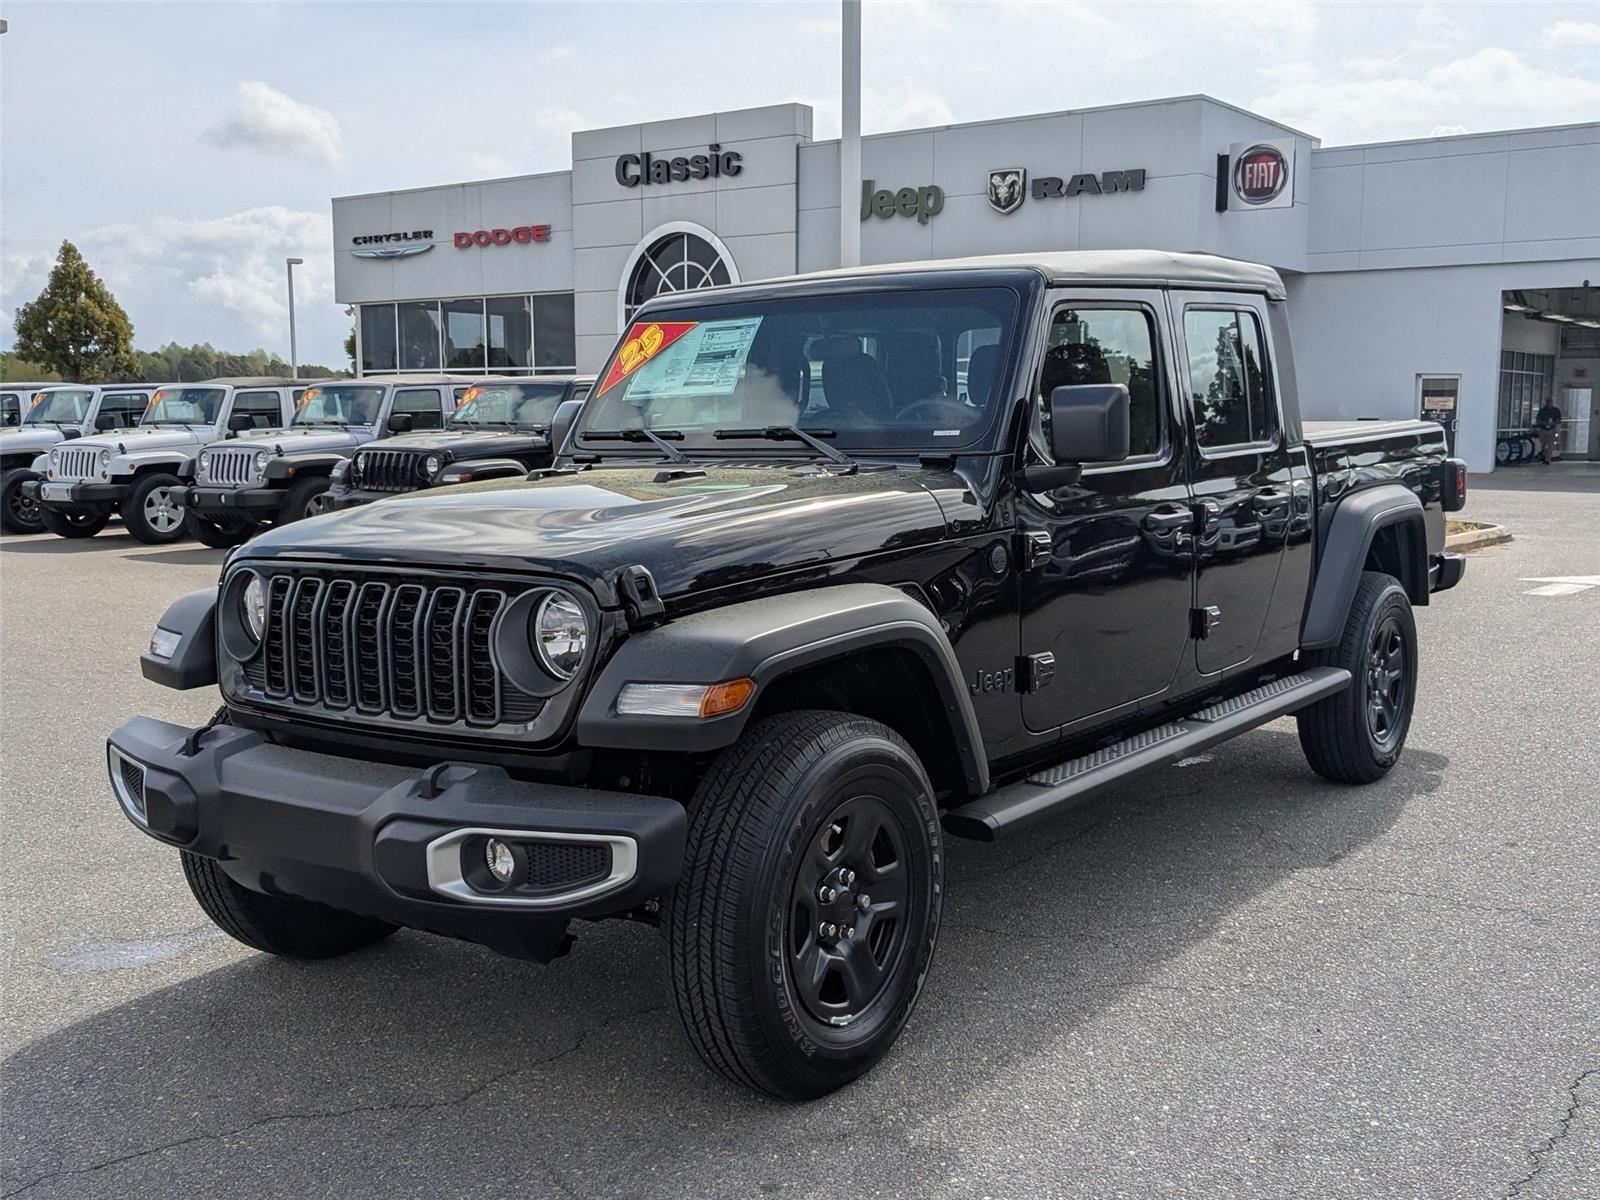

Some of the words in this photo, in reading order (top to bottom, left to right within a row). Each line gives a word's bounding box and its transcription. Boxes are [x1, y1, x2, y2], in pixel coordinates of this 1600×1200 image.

[615, 143, 742, 188] Classic
[1245, 162, 1277, 189] FIAT
[1031, 169, 1147, 200] RAM
[860, 180, 944, 224] Jeep
[352, 230, 434, 246] CHRYSLER
[454, 225, 551, 249] DODGE
[619, 324, 664, 375] 25
[970, 668, 1014, 697] Jeep
